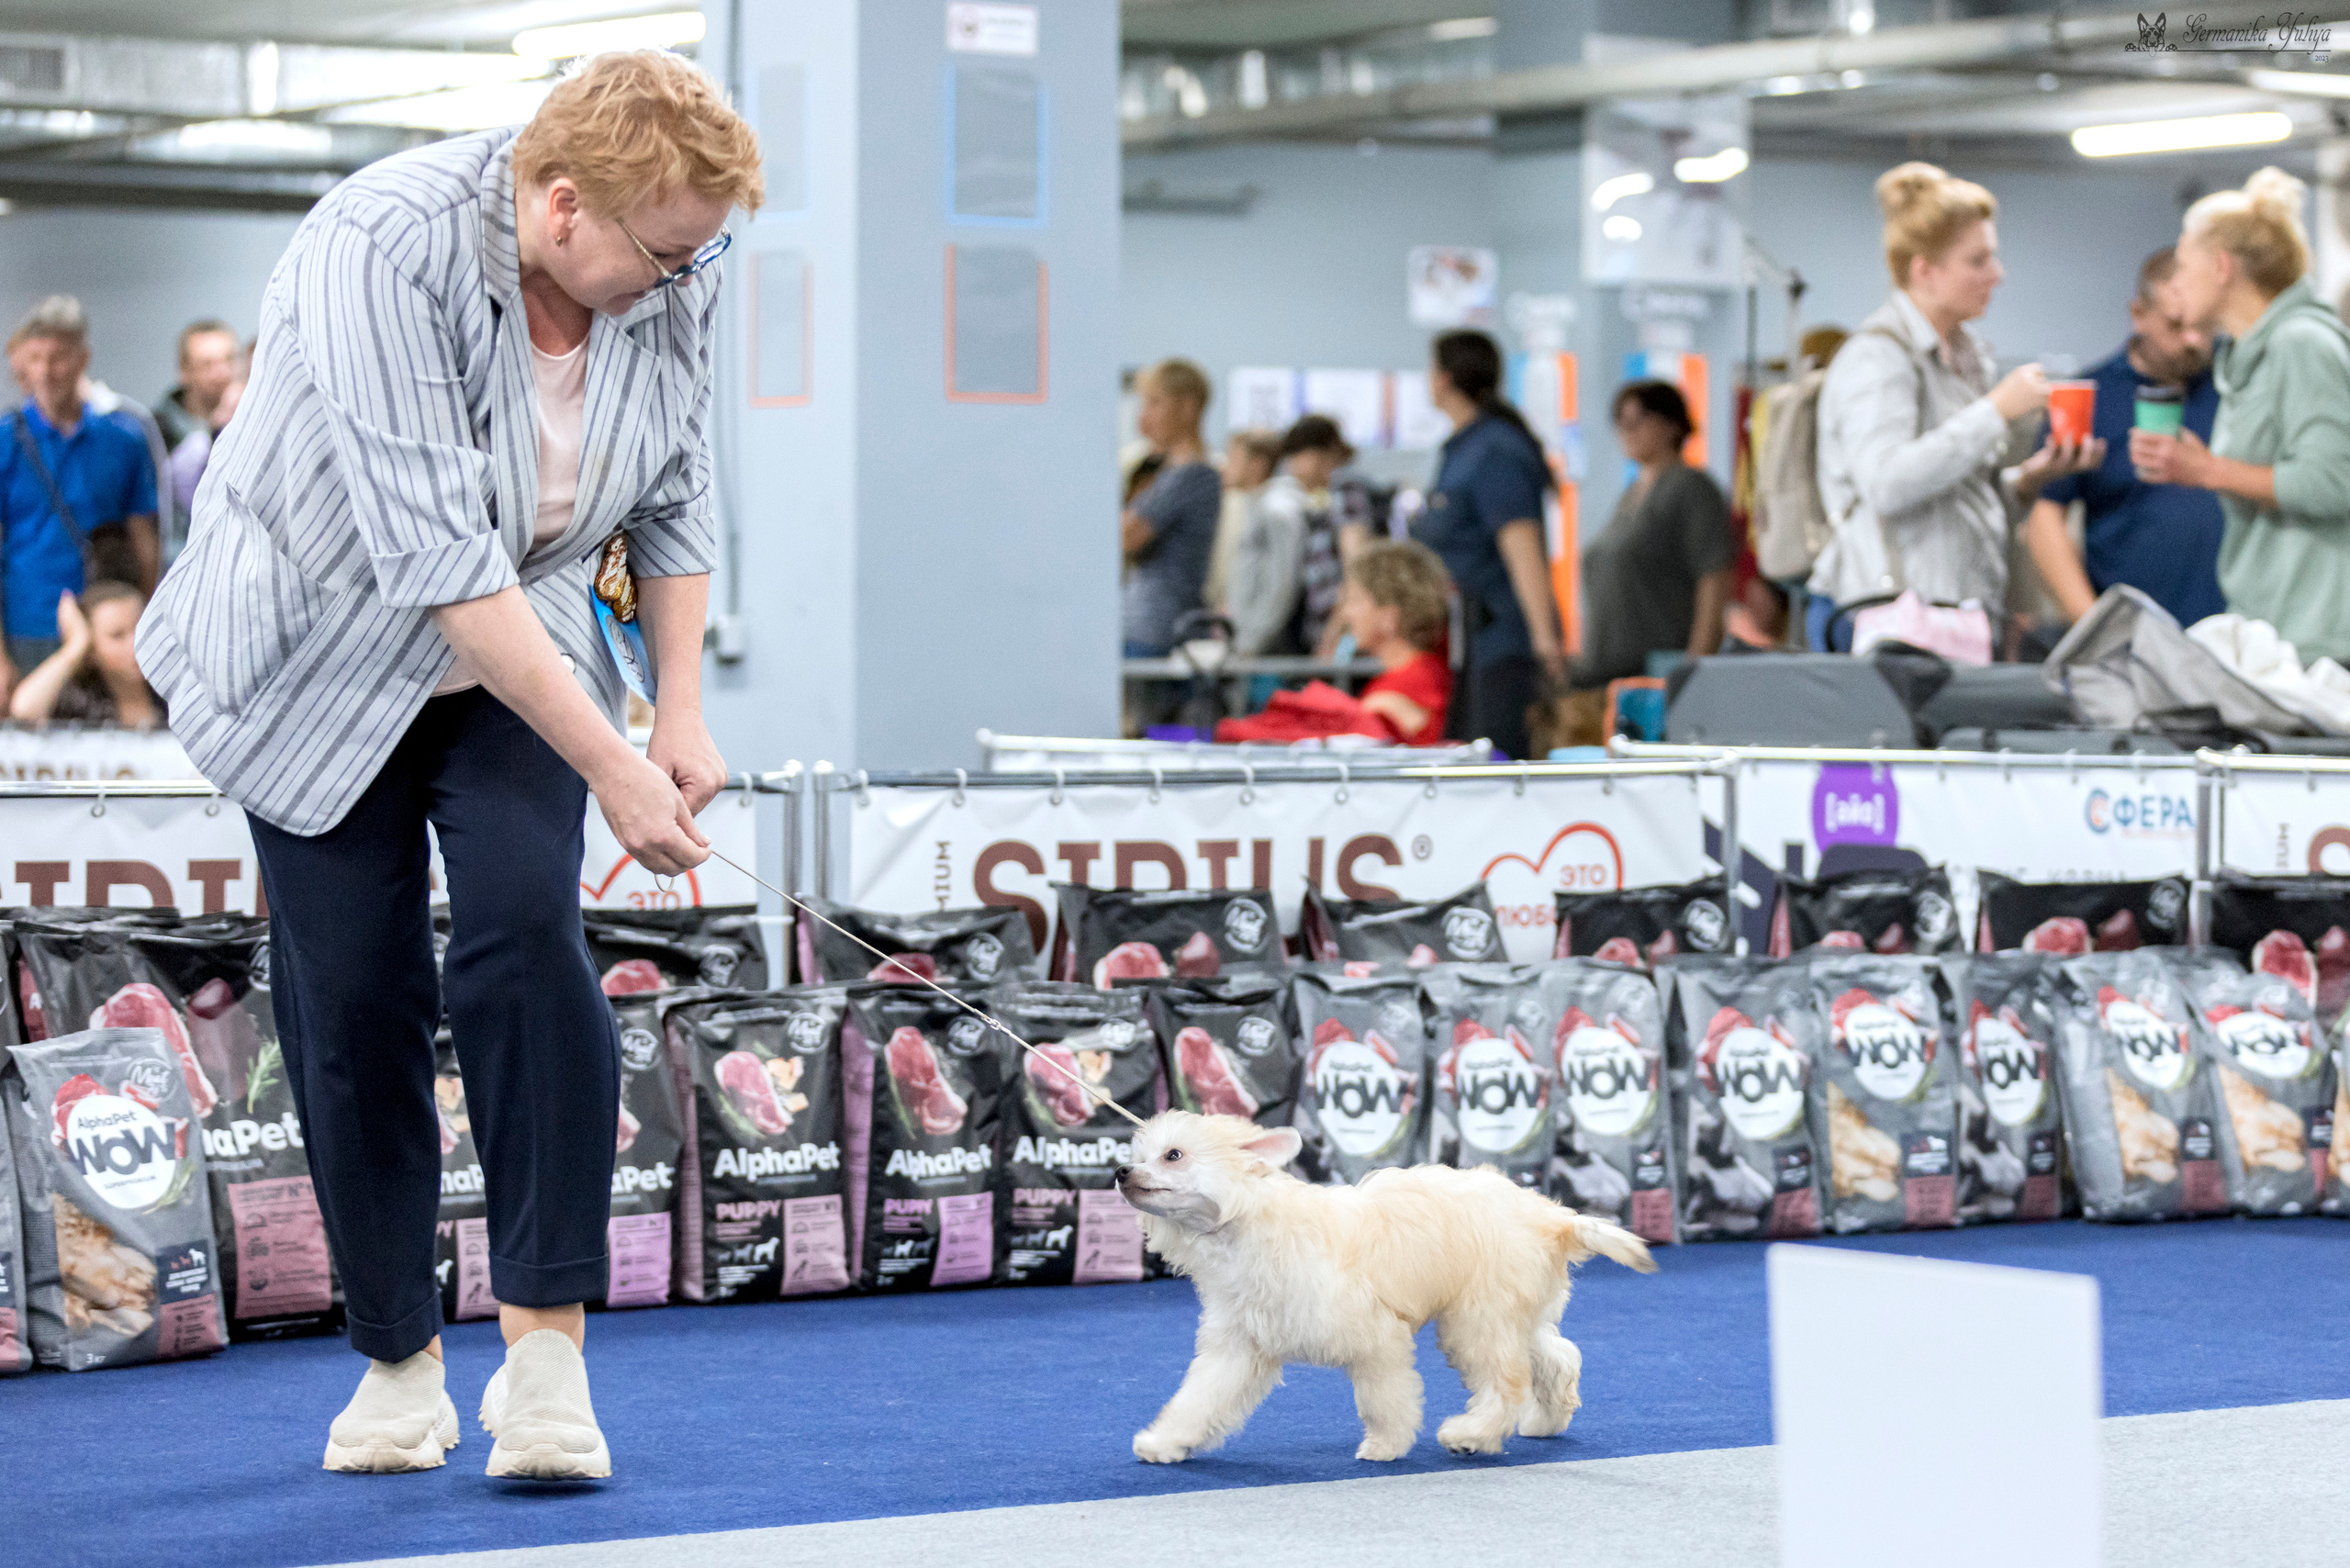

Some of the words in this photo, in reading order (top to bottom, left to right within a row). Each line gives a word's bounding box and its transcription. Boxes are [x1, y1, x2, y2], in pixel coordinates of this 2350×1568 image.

[2084, 787, 2198, 834] СФЕРА
[1560, 864, 1607, 887] ЭТО
[1307, 1074, 1412, 1119] WOW
[1452, 1070, 1546, 1115] WOW
[1558, 1056, 1651, 1101] WOW
[1709, 1058, 1808, 1103] WOW
[78, 1110, 138, 1131] AlphaPet
[63, 1122, 176, 1176] WOW
[713, 1140, 842, 1183] AlphaPet
[884, 1143, 993, 1183] AlphaPet
[1013, 1135, 1133, 1170] AlphaPe
[715, 1199, 781, 1221] PUPPY
[1013, 1187, 1076, 1207] PUPPY
